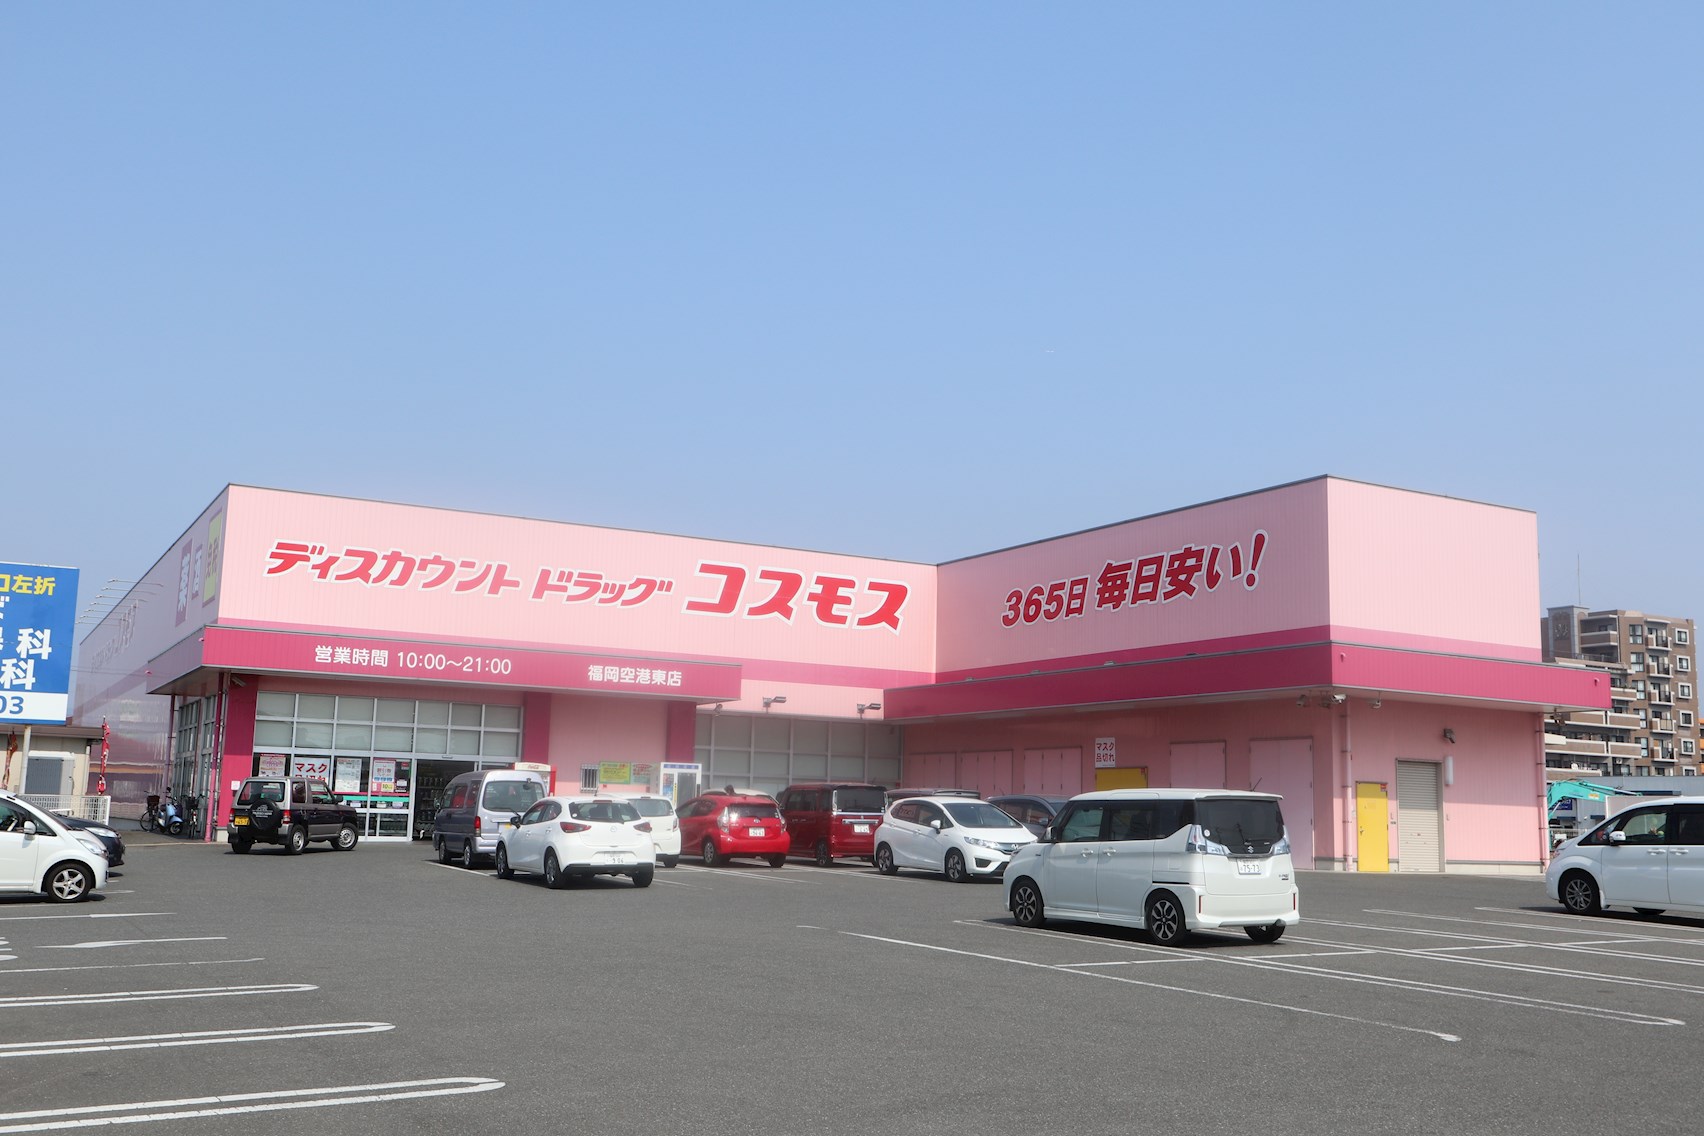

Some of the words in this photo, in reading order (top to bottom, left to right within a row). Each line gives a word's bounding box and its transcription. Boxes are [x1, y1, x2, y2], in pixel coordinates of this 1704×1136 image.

[264, 539, 522, 597] ディスカウント
[530, 566, 676, 608] ドラッグ
[682, 560, 911, 635] コスモス
[1002, 576, 1089, 627] 365日
[1096, 530, 1268, 611] 毎日安い!
[314, 645, 389, 667] 営業時間
[397, 651, 512, 675] 10:00～21:00
[588, 665, 682, 686] 福岡空港東店
[1096, 742, 1115, 751] マスク
[295, 763, 328, 773] マスク
[1096, 753, 1115, 762] 品切れ
